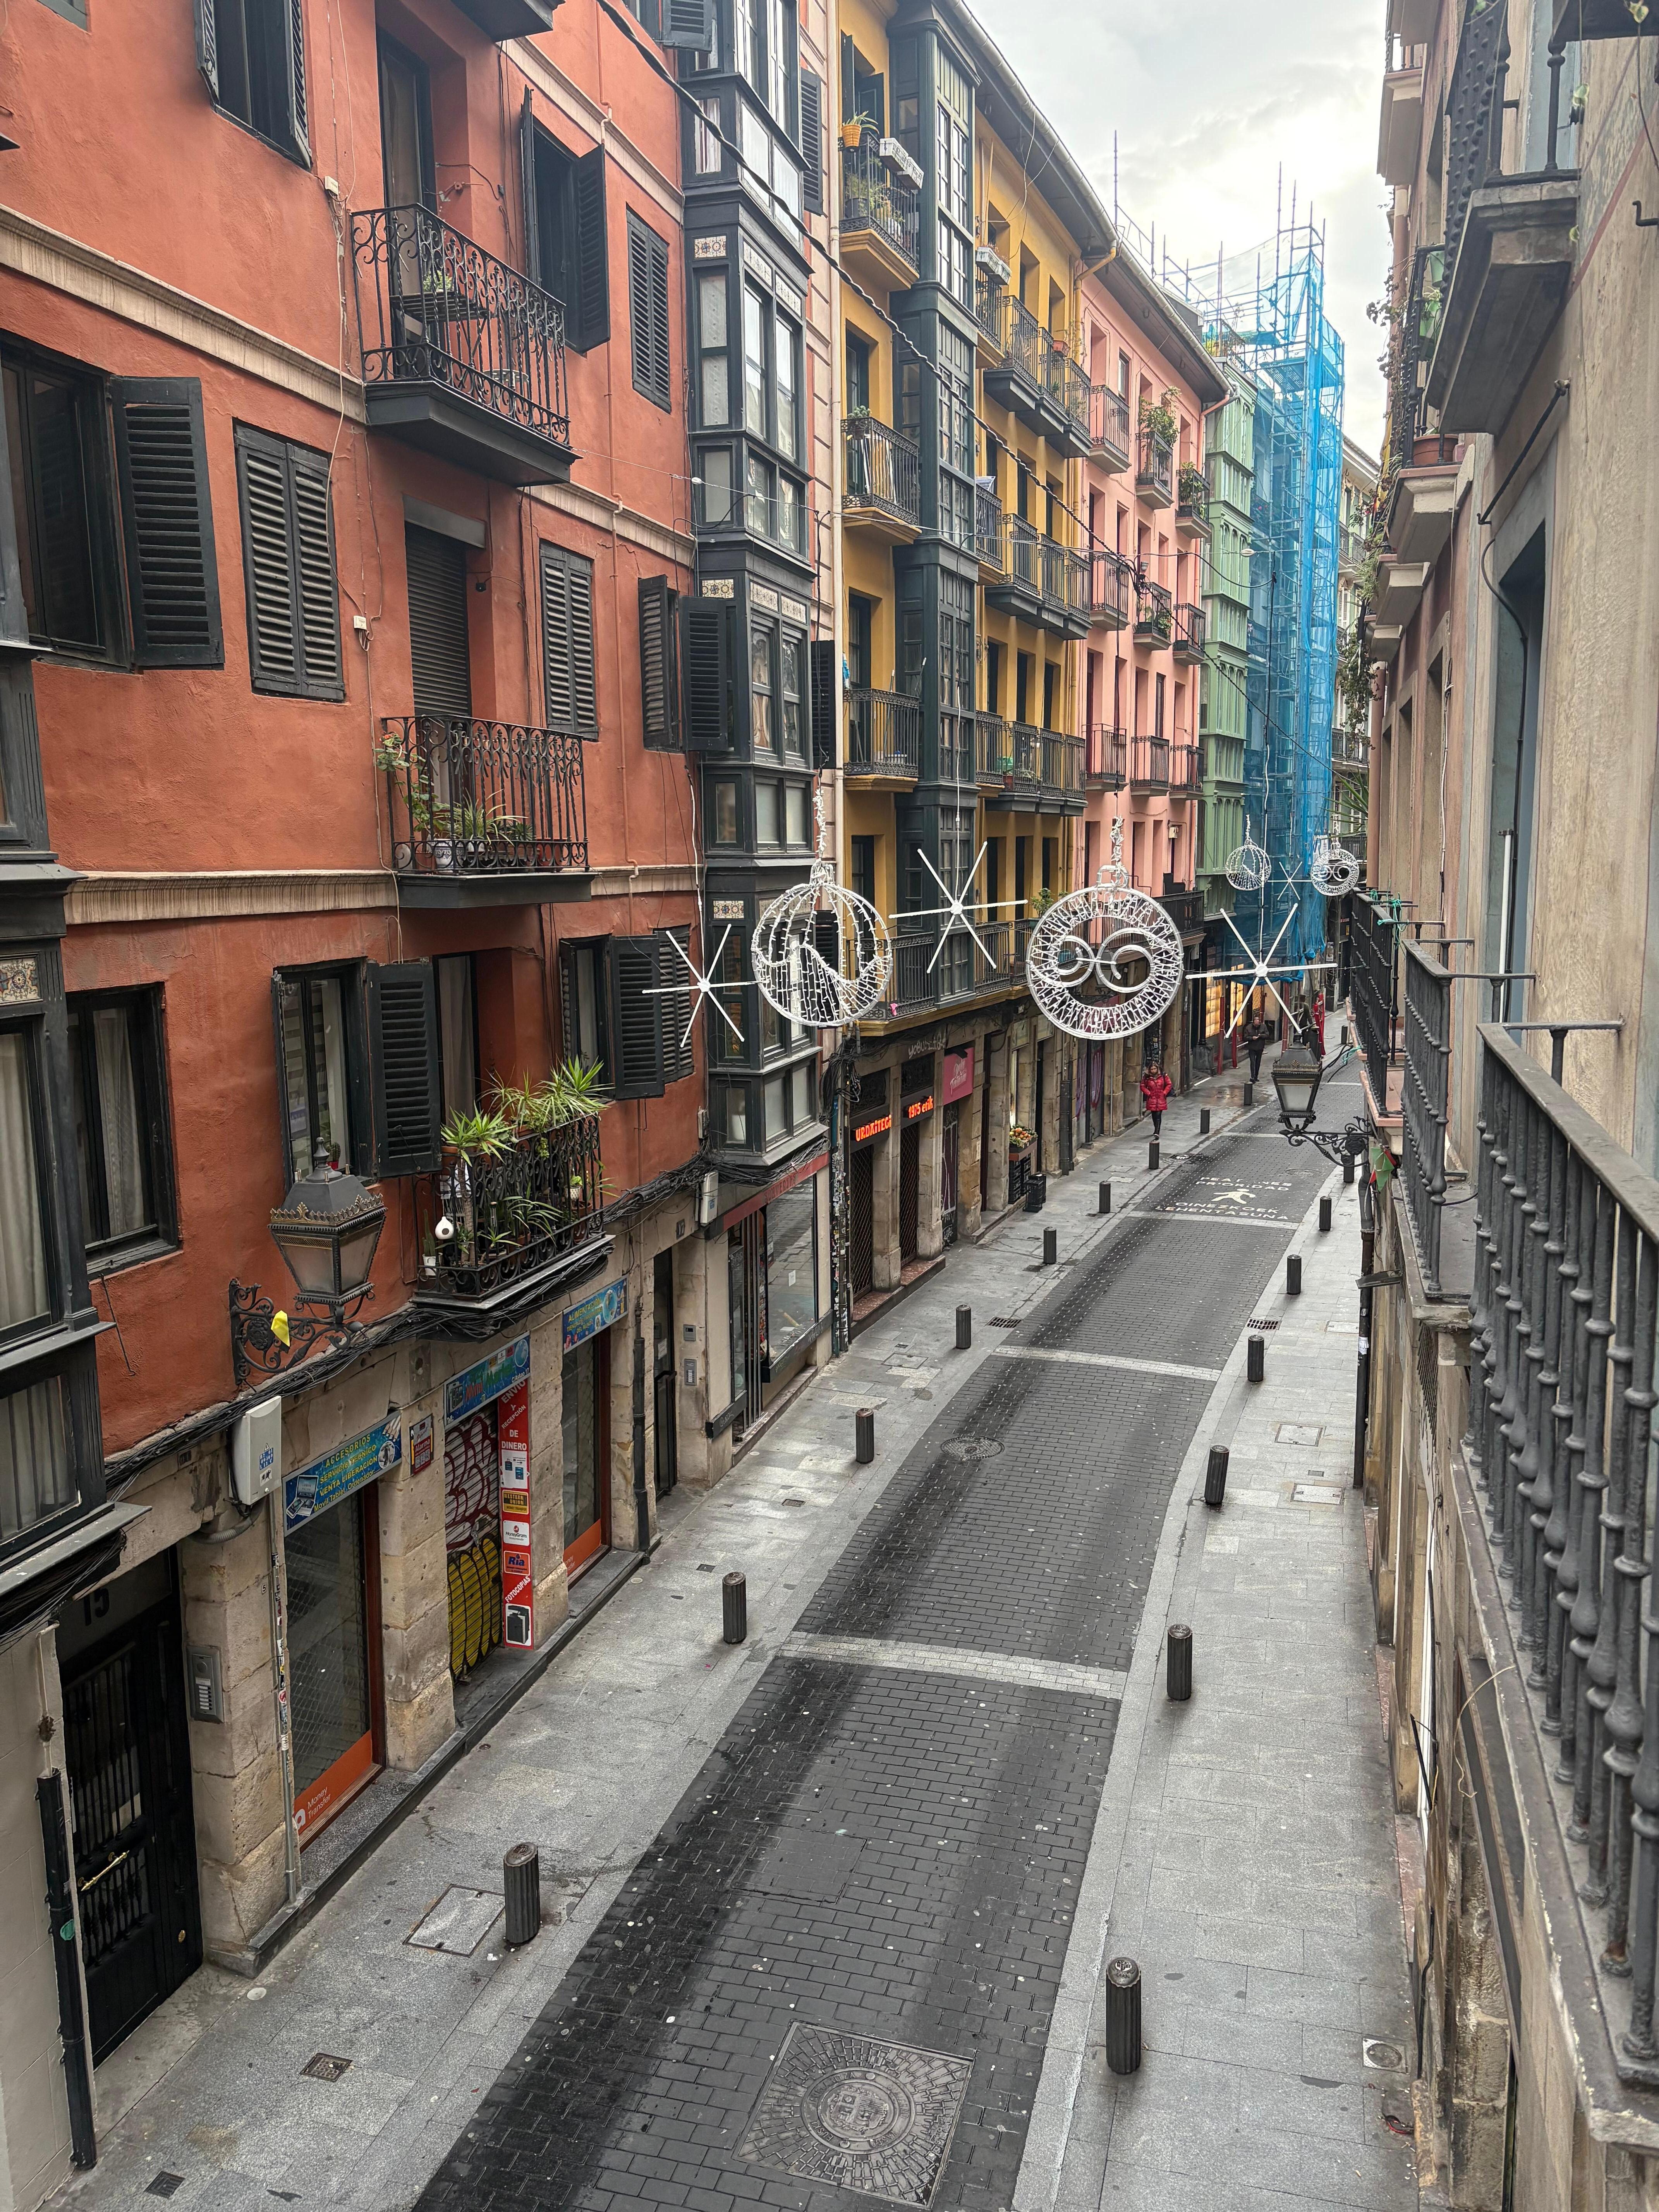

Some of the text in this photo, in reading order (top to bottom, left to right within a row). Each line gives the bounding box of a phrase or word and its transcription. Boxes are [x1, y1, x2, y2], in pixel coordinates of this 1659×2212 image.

[908, 1102, 921, 1119] 1975
[922, 1095, 934, 1113] etik
[1175, 1202, 1279, 1214] OINEZKOEK
[501, 1404, 526, 1429] RECEPCIÓN
[509, 1429, 519, 1438] DE
[325, 1434, 371, 1468] ACCESORIOS
[415, 1439, 430, 1453] Alarma
[501, 1441, 527, 1451] DINERO
[319, 1455, 378, 1496] VENTA LIBERACION
[320, 1444, 377, 1484] SERVICIO TECNICO
[508, 1554, 525, 1566] Ria
[505, 1575, 531, 1603] FOTOCOPIAS
[307, 1786, 328, 1810] Money
[307, 1793, 331, 1819] Transfer
